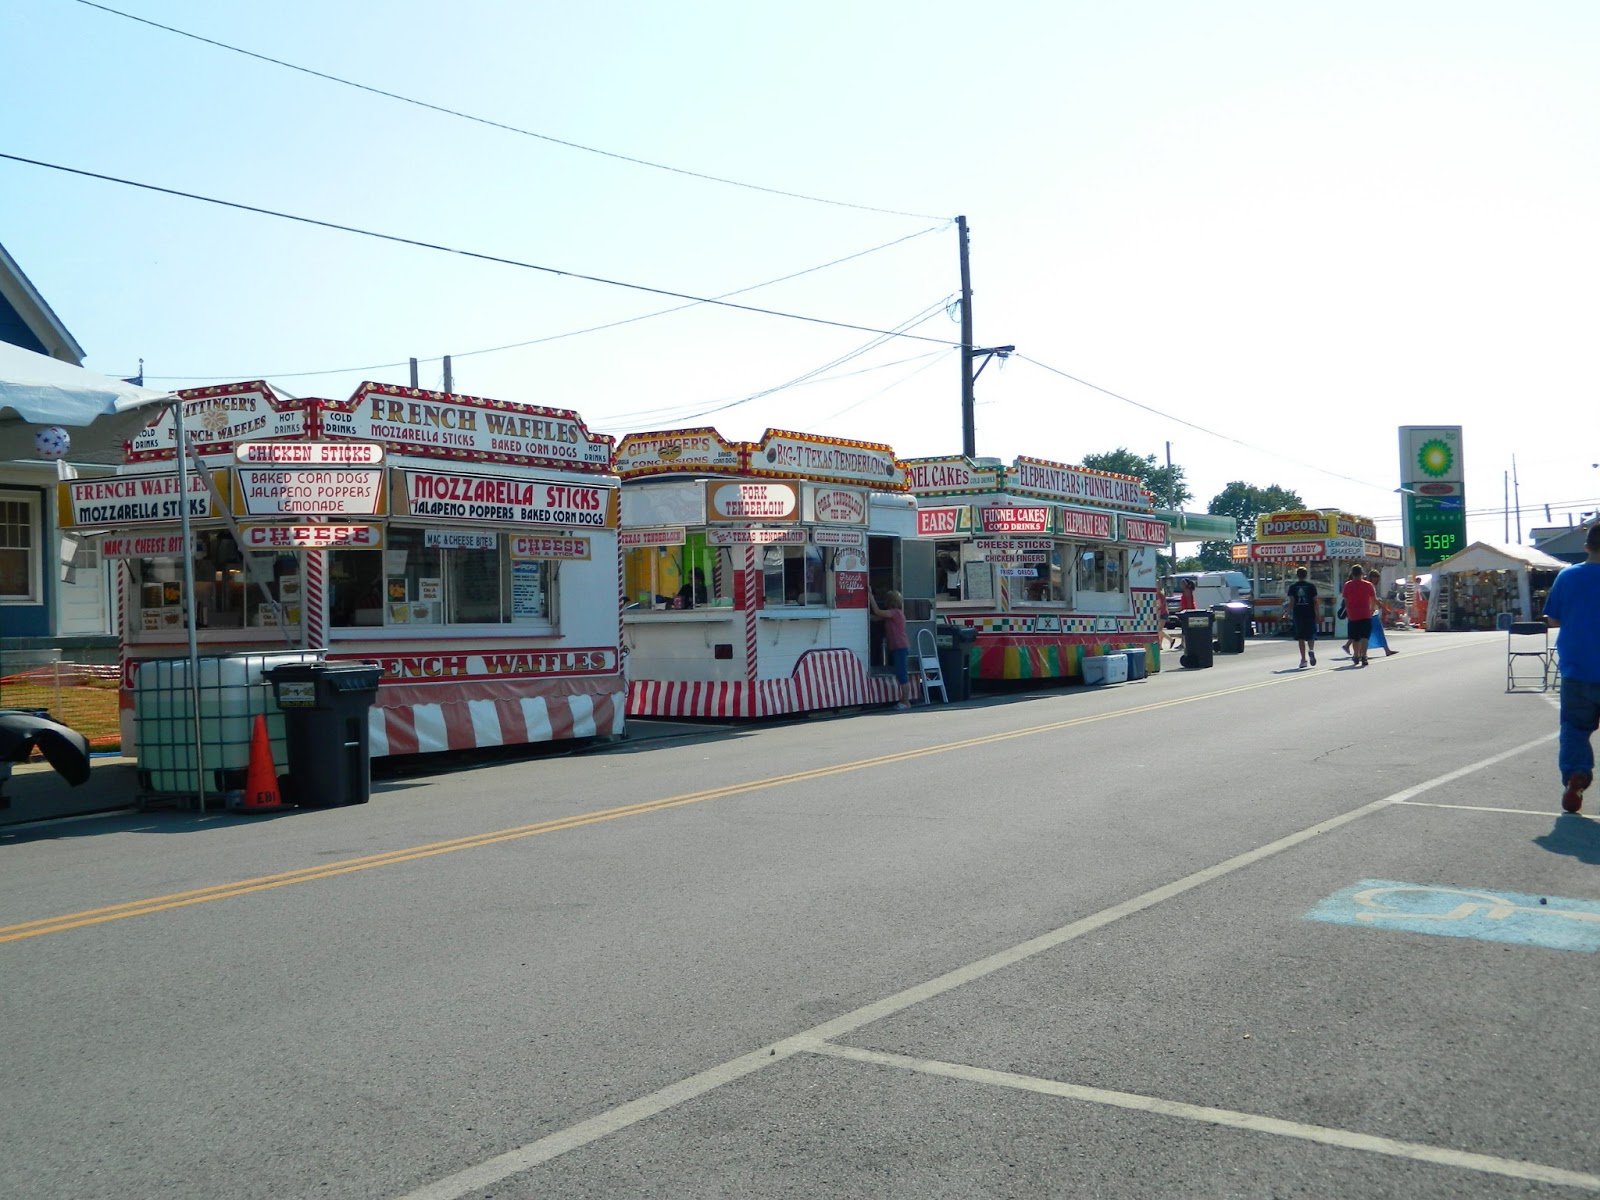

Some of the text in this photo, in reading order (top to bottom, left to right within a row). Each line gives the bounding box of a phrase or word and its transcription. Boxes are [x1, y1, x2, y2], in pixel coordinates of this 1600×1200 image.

[183, 398, 256, 418] ITTINGER'S
[279, 413, 295, 422] HOT
[330, 412, 352, 423] COLD
[371, 397, 578, 444] FRENCH WAFFLES
[168, 415, 266, 441] FNCH WAFFLES
[275, 424, 300, 434] DRINKS
[325, 423, 356, 434] DRINKS
[371, 424, 577, 458] MOZZARELLA STICKS BAKED CORN DOGS
[588, 444, 602, 452] HOT
[627, 437, 711, 458] GITTINGER'S
[248, 445, 371, 461] CHICKEN STICKS
[584, 453, 606, 463] DRINKS
[777, 444, 886, 476] BIG-T TEXAS TENDERLOIN
[631, 456, 708, 469] CONCESSIONS
[251, 472, 369, 484] BAKED CORN DOGS
[931, 465, 969, 487] CAKES
[75, 480, 137, 501] FRENCH
[250, 486, 371, 498] JALAPENO POPPERS
[1020, 465, 1139, 504] ELEPHANT EARS FUNNEL CAKES
[414, 475, 600, 511] MOZZARELLA STICKS
[742, 486, 767, 500] PORK
[79, 498, 207, 523] MOZZARELLA STIKS
[277, 500, 344, 512] LEMONADE
[413, 499, 604, 525] JALAPENO POPPERS BAKED CORN DOGS
[726, 501, 784, 516] TENDERLOIN
[921, 511, 955, 532] EARS
[983, 509, 1045, 523] FUNNEL CAKES
[989, 523, 1041, 531] COLD DRINKS
[1066, 512, 1109, 537] ELEPHANT EARS
[1127, 519, 1165, 542] FUNNEL CAKES
[1263, 518, 1329, 536] POPCORN
[251, 527, 370, 544] CHEESE
[427, 534, 441, 546] MAC
[476, 536, 493, 548] BITES
[621, 531, 681, 544] TEXAS TENDERLOIN
[733, 531, 756, 541] TEXAS
[760, 531, 803, 542] TENDERLOIN
[104, 540, 122, 556] MAC
[135, 537, 166, 554] CHEESE
[168, 536, 194, 553] BITS
[517, 538, 584, 555] CHEESE
[976, 540, 1052, 549] CHEESE STICKS
[1260, 545, 1316, 555] COTTON CANDY
[1328, 540, 1364, 549] LEMONADE
[985, 554, 1045, 562] CHICKEN FINGERS
[520, 563, 537, 571] PEPS
[380, 651, 606, 678] ENCH WAFFLES
